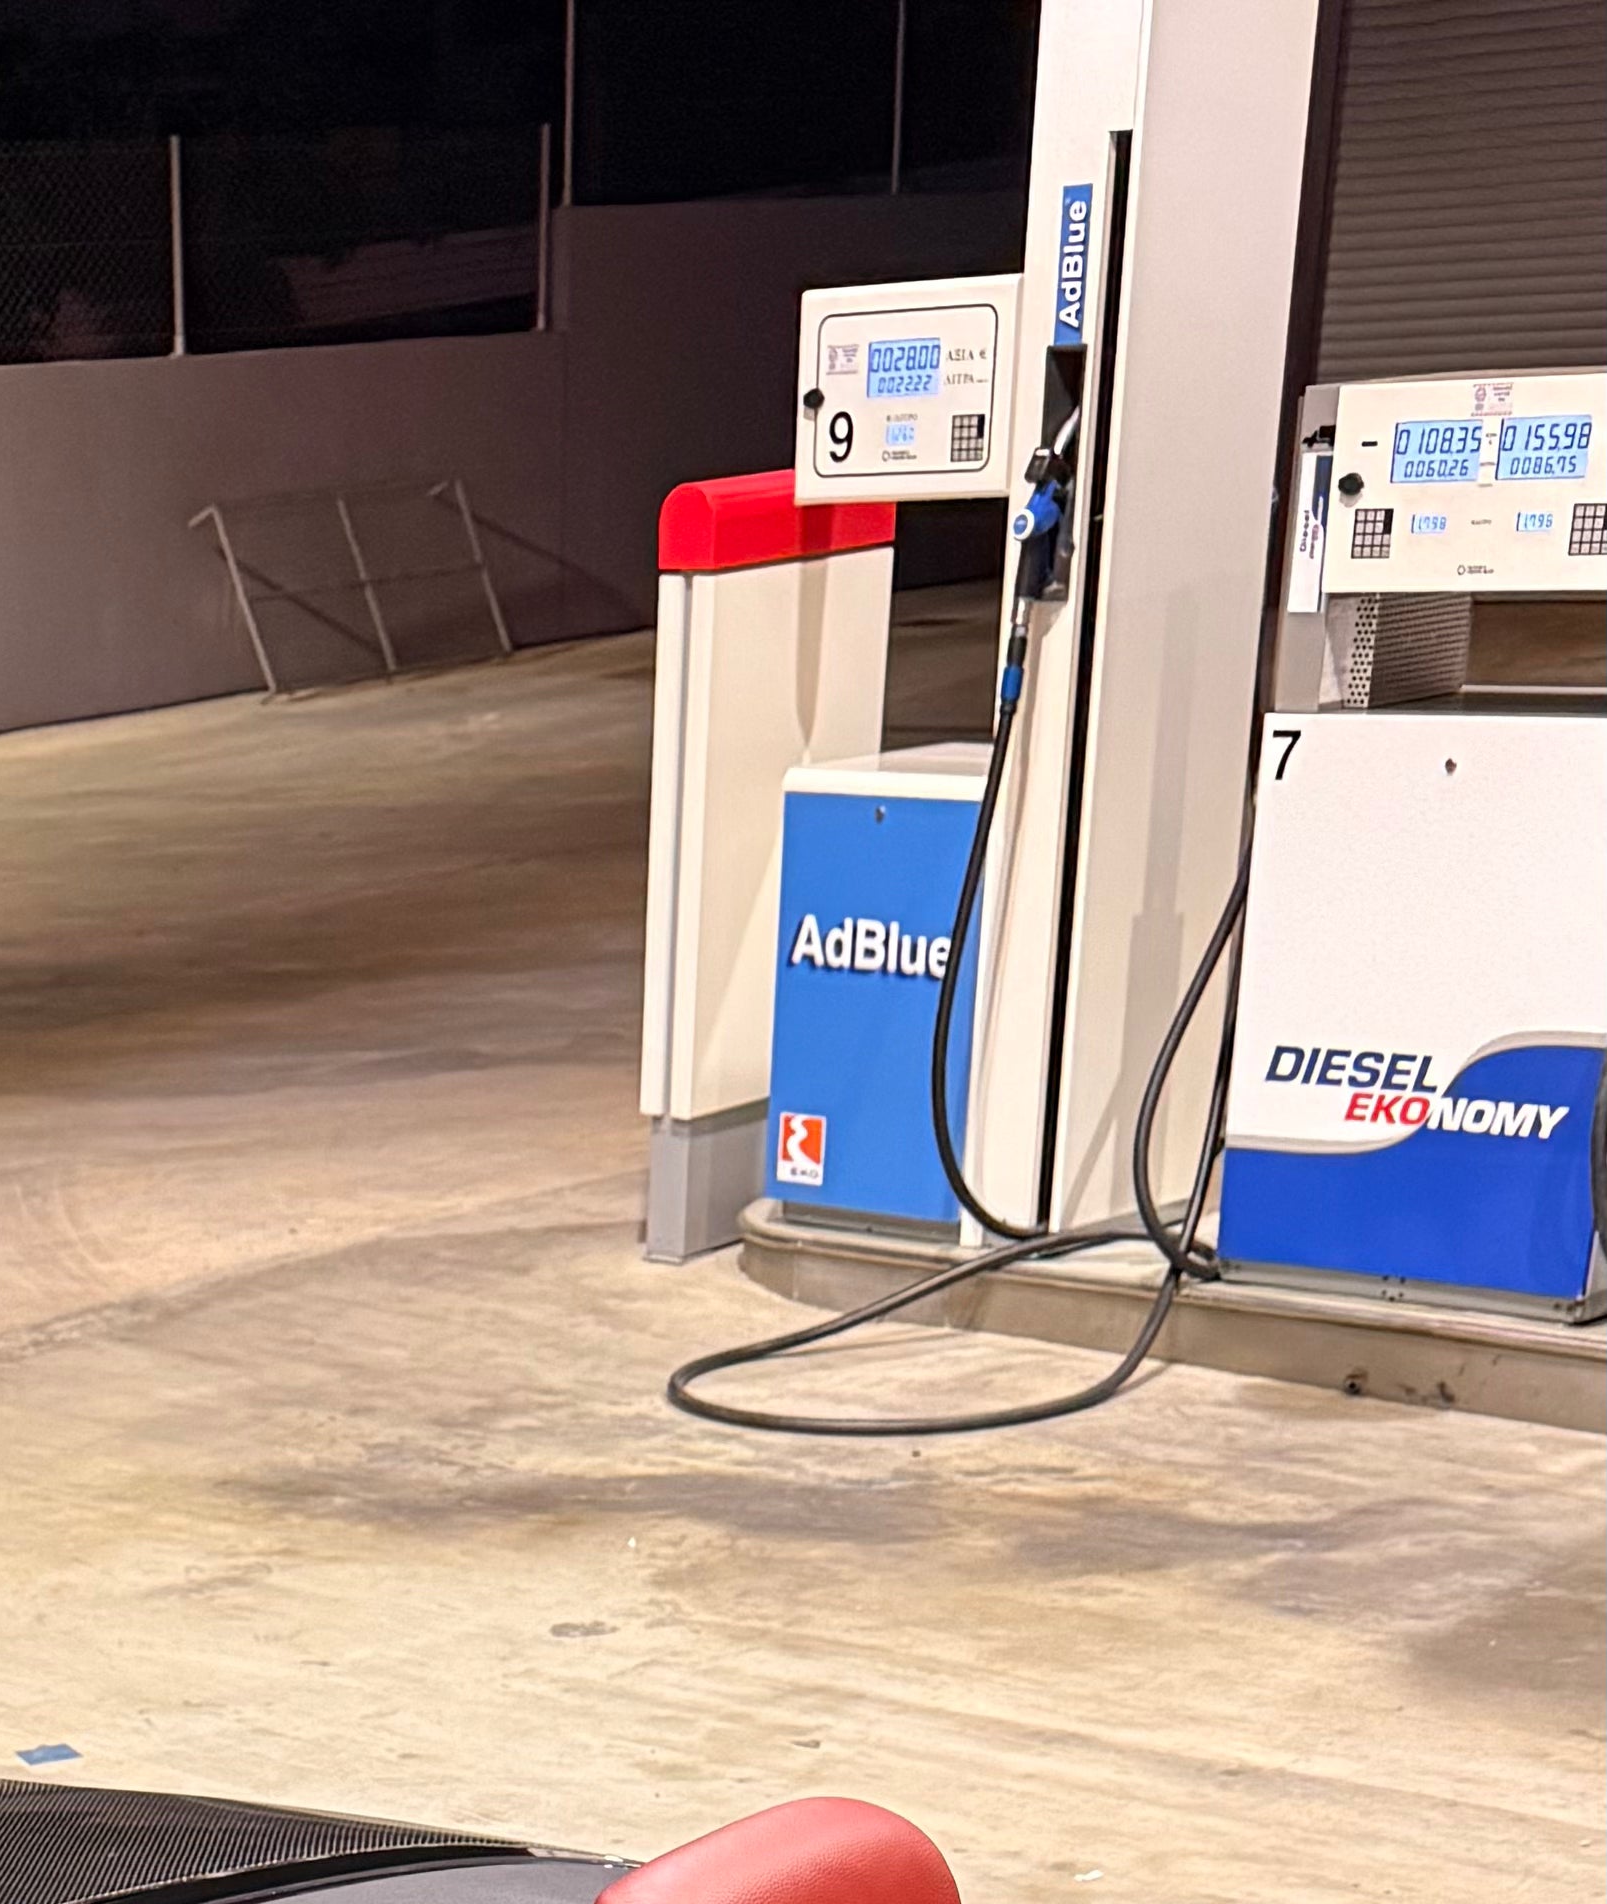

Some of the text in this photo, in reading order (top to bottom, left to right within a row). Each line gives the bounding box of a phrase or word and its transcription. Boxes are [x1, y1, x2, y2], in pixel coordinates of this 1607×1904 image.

[1059, 200, 1087, 328] AdBlue
[829, 411, 854, 463] 9
[1272, 729, 1302, 781] 7
[791, 913, 952, 980] AdBlue
[1265, 1045, 1438, 1093] DIESEL
[1344, 1092, 1570, 1140] EKONOMY
